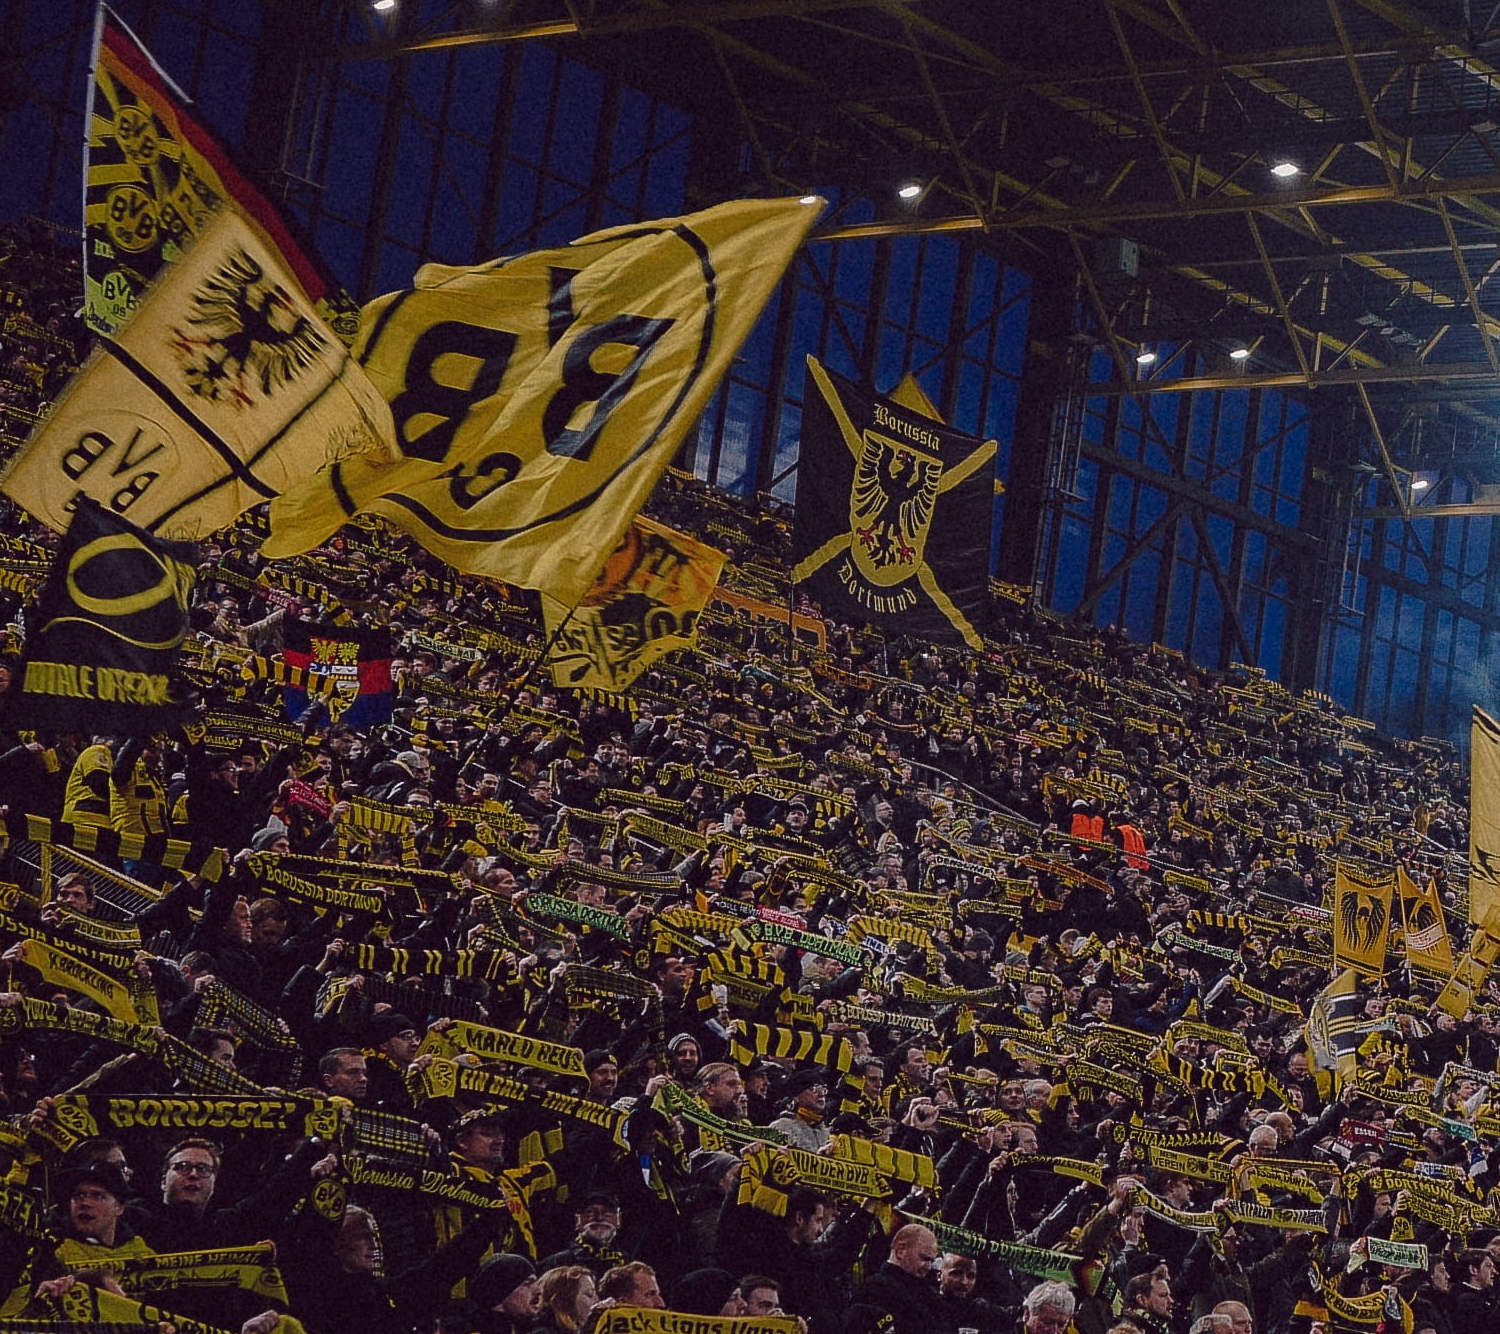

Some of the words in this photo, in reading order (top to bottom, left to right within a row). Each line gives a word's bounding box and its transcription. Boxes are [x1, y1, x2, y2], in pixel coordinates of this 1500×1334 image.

[111, 191, 158, 239] BVB
[874, 403, 941, 452] Borussia
[838, 557, 917, 614] Dortmund
[266, 865, 325, 901] BORUSSIA
[326, 885, 383, 915] DORTMUND
[537, 1042, 583, 1074] REUS
[108, 1098, 297, 1129] BORUSSE!
[460, 1069, 488, 1093] EIN
[489, 1075, 528, 1102] BALL
[541, 1090, 575, 1115] EINE
[576, 1100, 614, 1129] WELT
[341, 1153, 415, 1191] Borussia
[820, 1159, 846, 1181] DER
[847, 1165, 872, 1186] BVB
